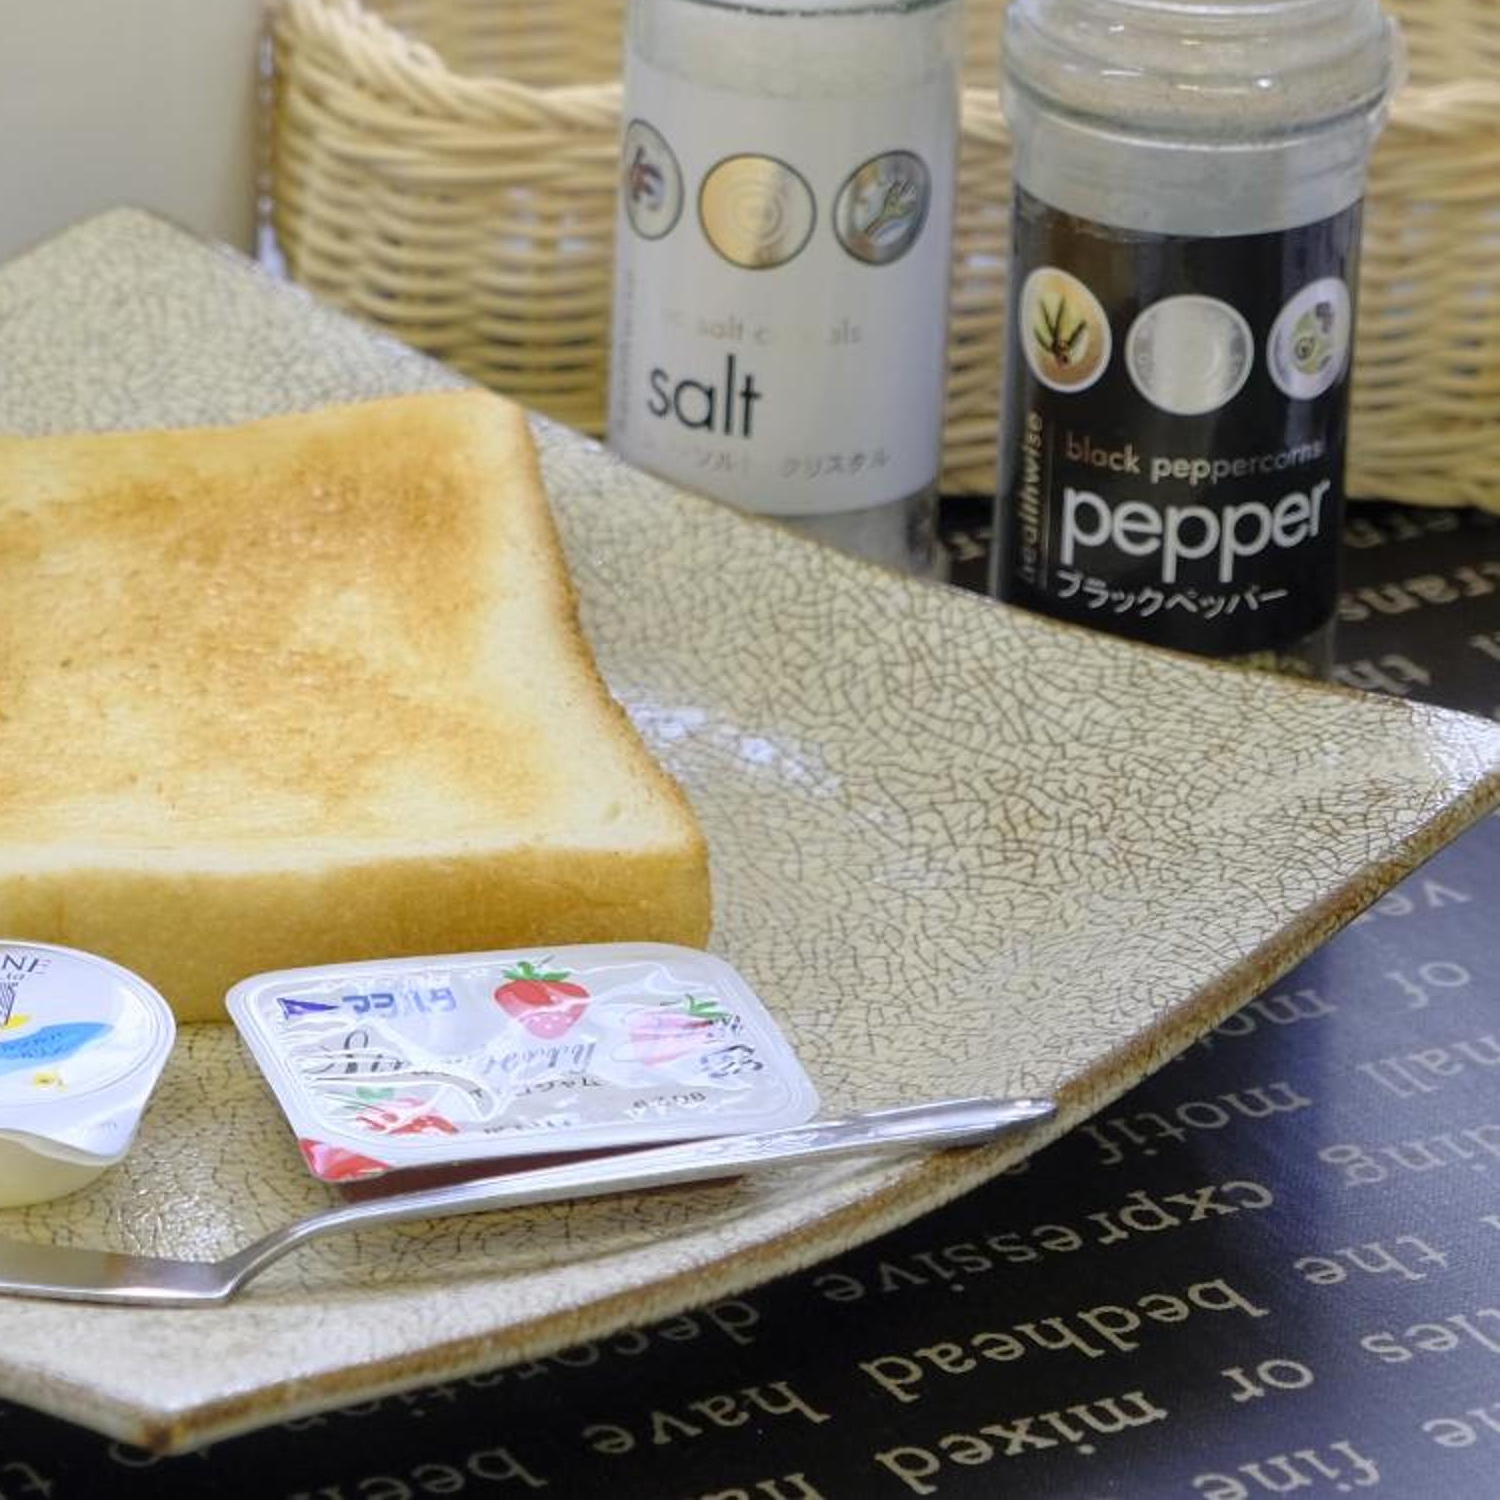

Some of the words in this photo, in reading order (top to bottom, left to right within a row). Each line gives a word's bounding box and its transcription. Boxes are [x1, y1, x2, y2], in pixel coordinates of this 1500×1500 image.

[647, 353, 763, 438] salt
[1065, 432, 1141, 475] black
[1060, 479, 1331, 585] pepper
[1384, 959, 1472, 1010] of
[1080, 1080, 1313, 1165] motif
[1293, 1235, 1448, 1286] the
[858, 1278, 1269, 1403] bedhead
[582, 1381, 830, 1456] have
[1219, 1359, 1315, 1403] or
[873, 1391, 1168, 1496] mixed
